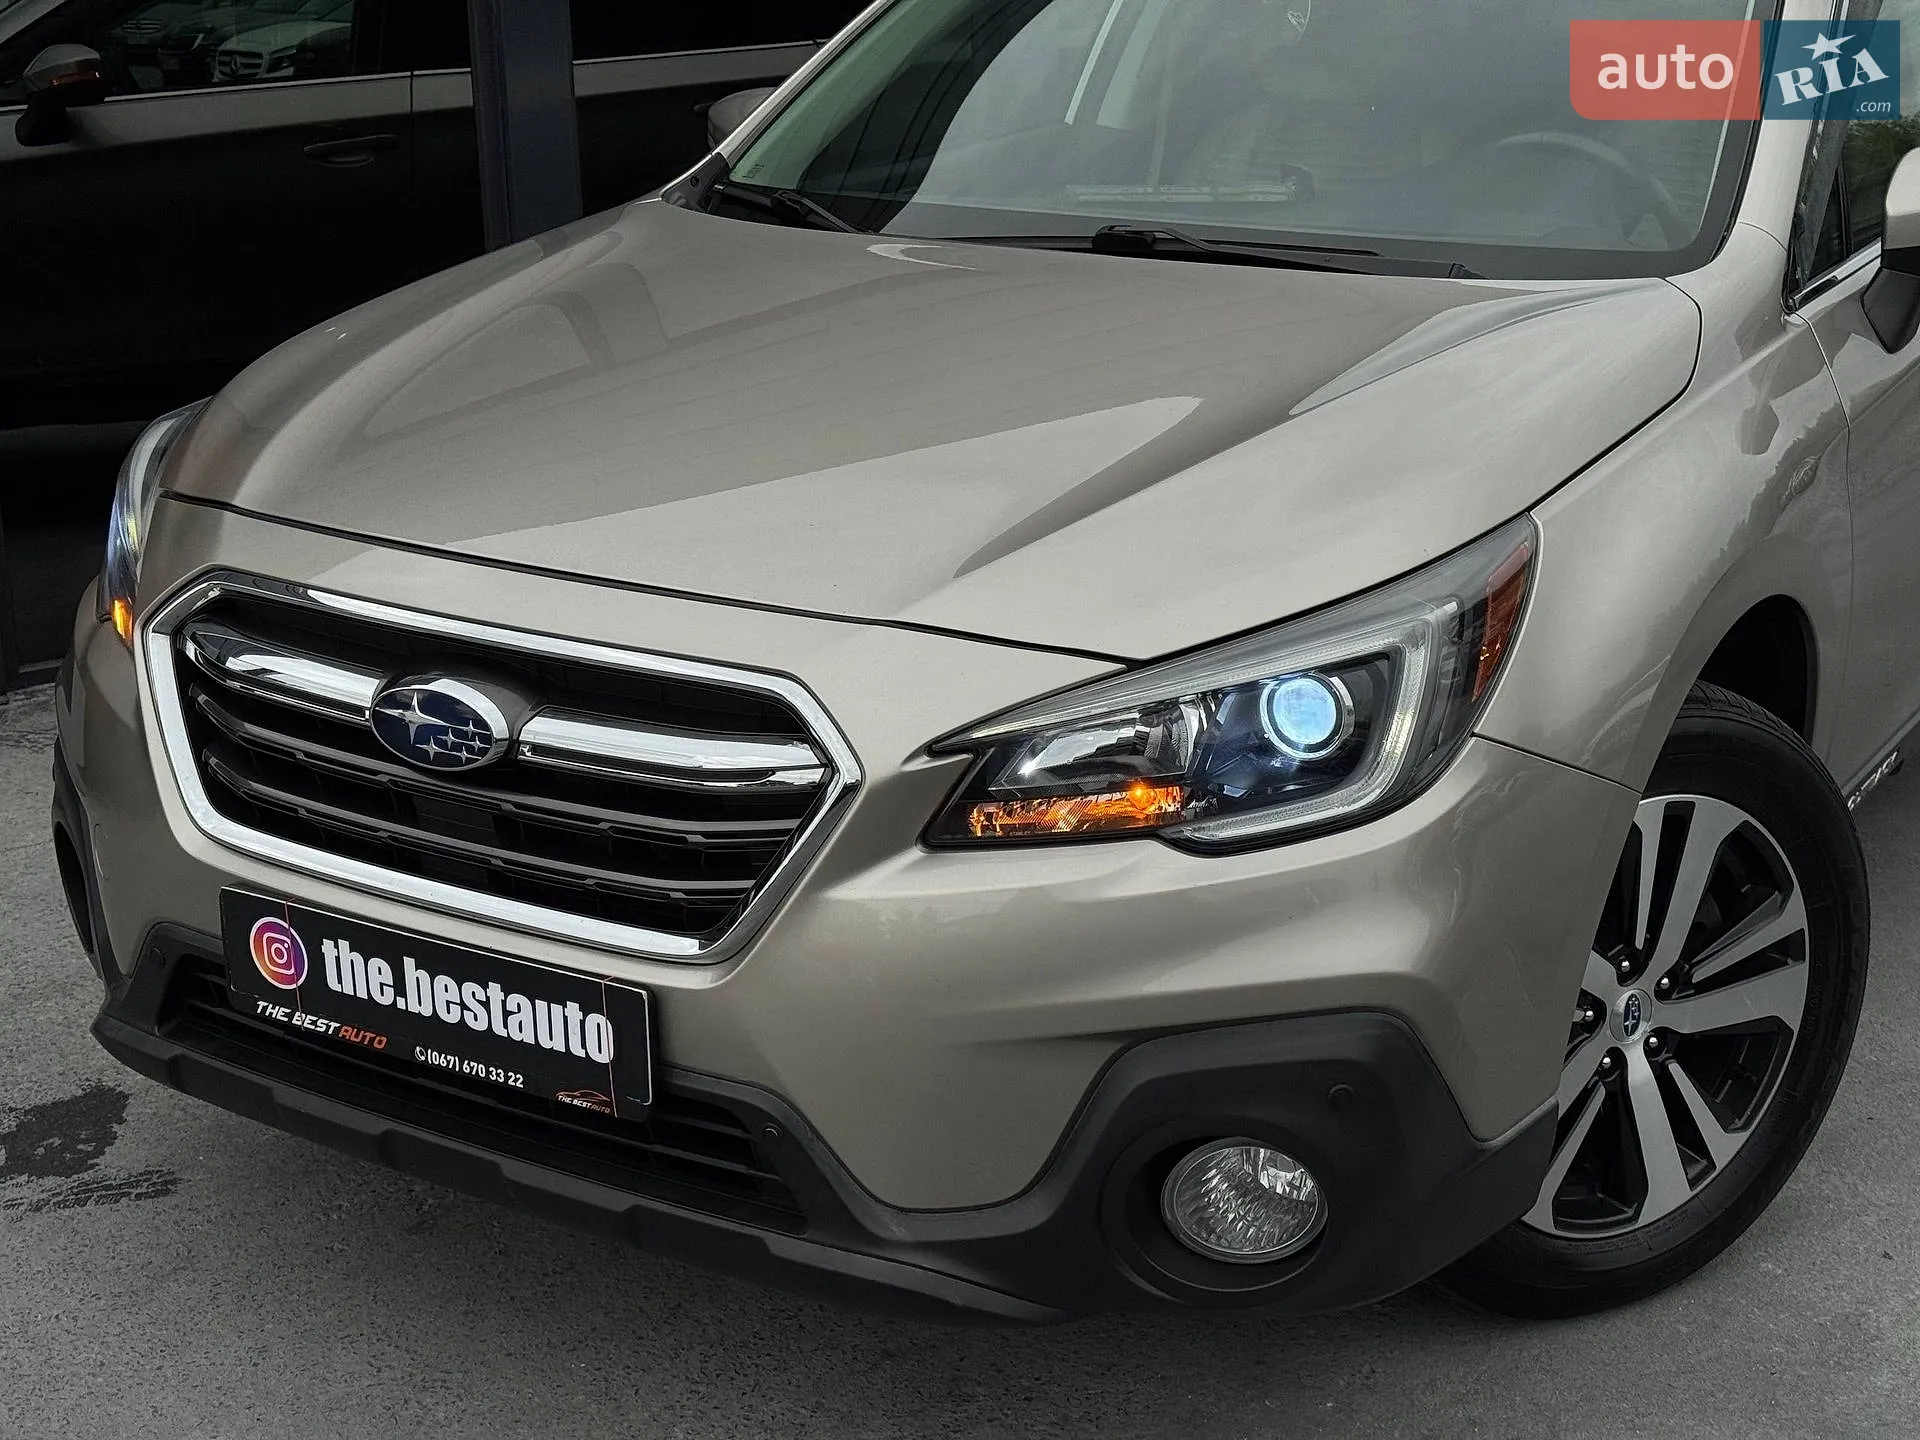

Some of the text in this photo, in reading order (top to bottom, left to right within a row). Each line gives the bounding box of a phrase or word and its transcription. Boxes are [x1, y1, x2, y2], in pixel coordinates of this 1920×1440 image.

[256, 1000, 292, 1021] THE
[321, 938, 614, 1064] the.bestauto
[427, 1048, 524, 1088] (067) 670 33 22
[557, 1095, 572, 1104] THE
